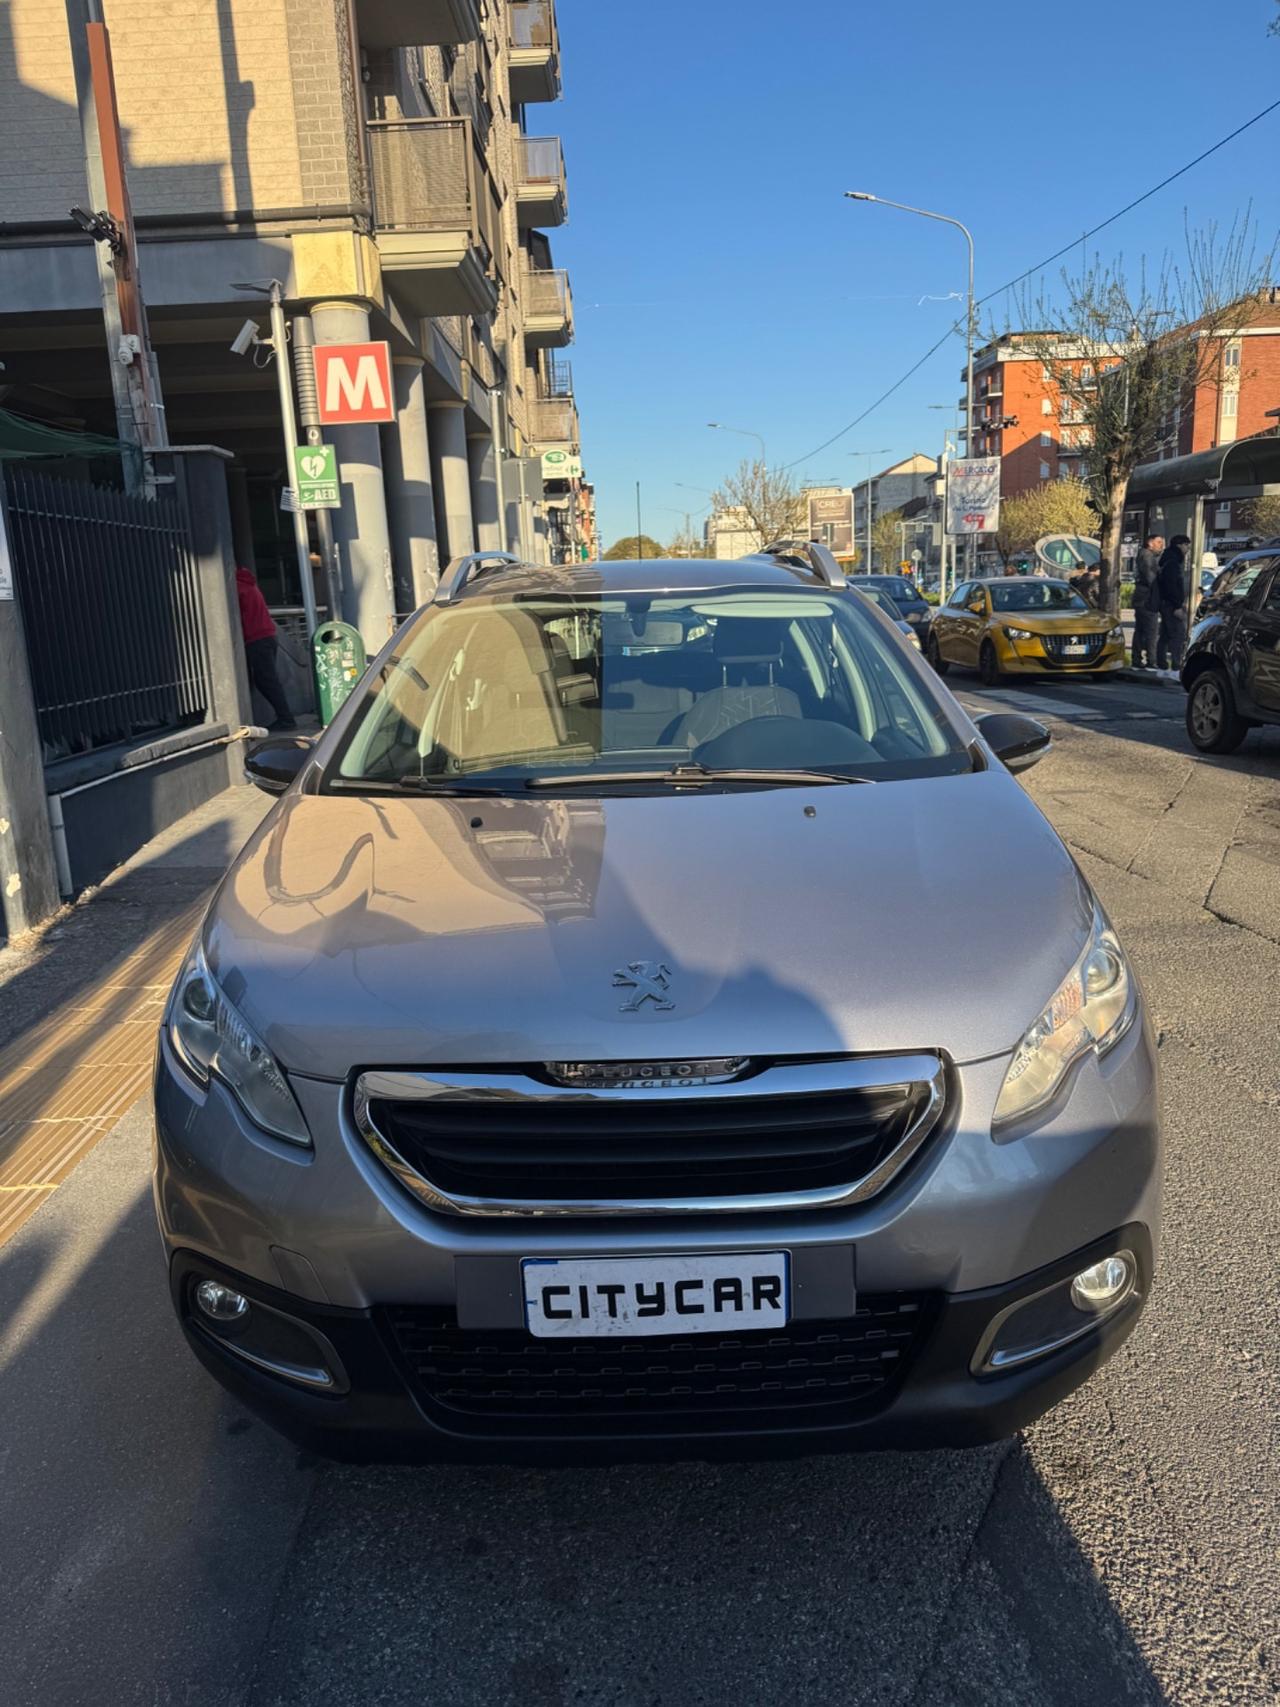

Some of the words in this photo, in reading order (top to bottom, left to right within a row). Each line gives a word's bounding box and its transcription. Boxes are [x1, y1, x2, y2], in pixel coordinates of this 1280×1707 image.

[325, 355, 387, 412] M
[314, 489, 336, 500] AED
[584, 1064, 710, 1077] PEUGEOT
[541, 1275, 782, 1319] CITYCAR
